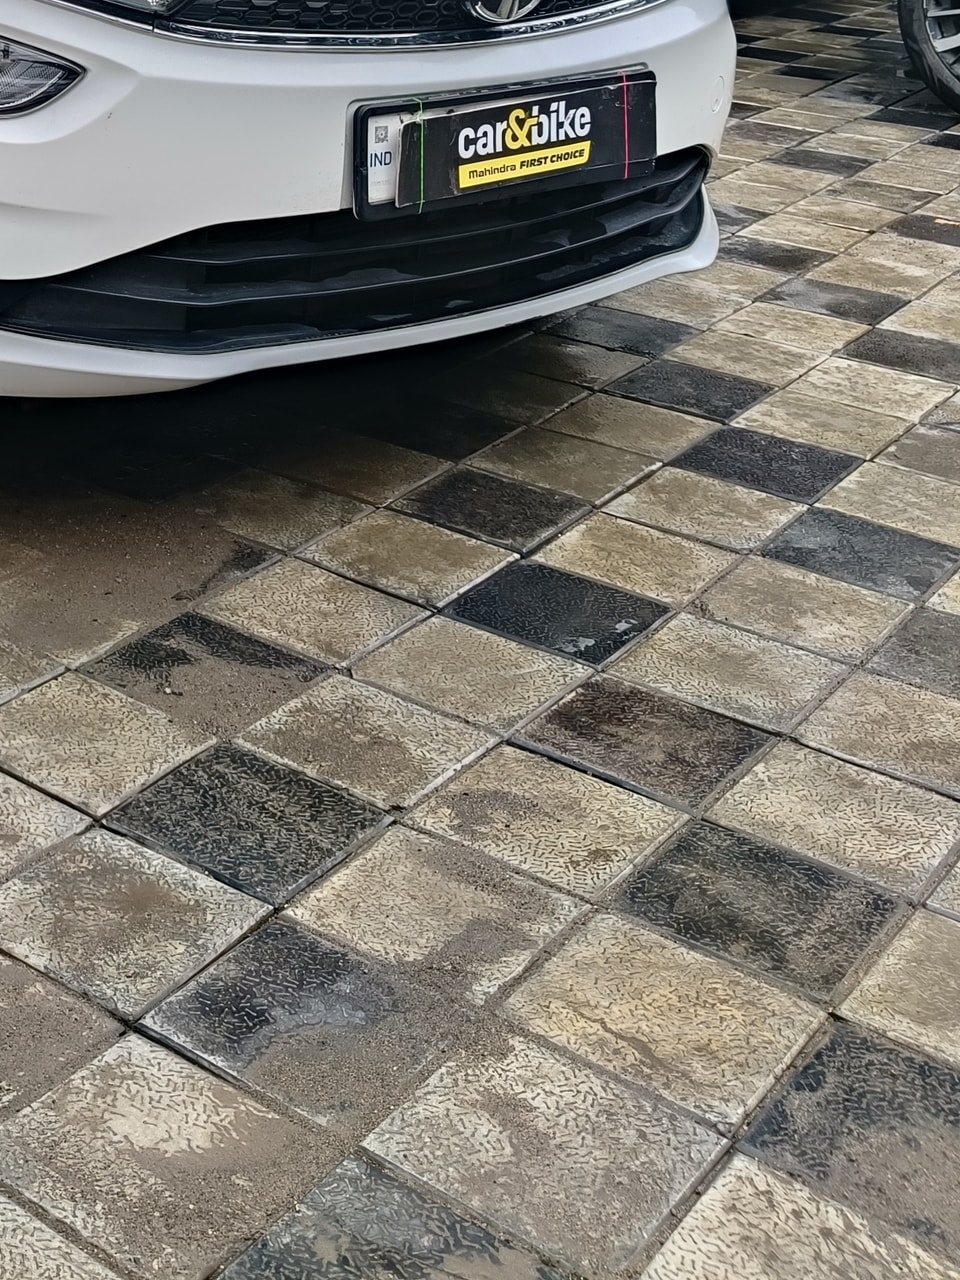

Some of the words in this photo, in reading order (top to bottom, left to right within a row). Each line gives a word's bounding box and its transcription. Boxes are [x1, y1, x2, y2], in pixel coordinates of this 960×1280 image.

[458, 100, 591, 160] car&bike
[369, 150, 393, 168] IND
[468, 162, 517, 180] Mahindra
[519, 155, 549, 170] FIRST
[549, 148, 585, 165] CHOICE
